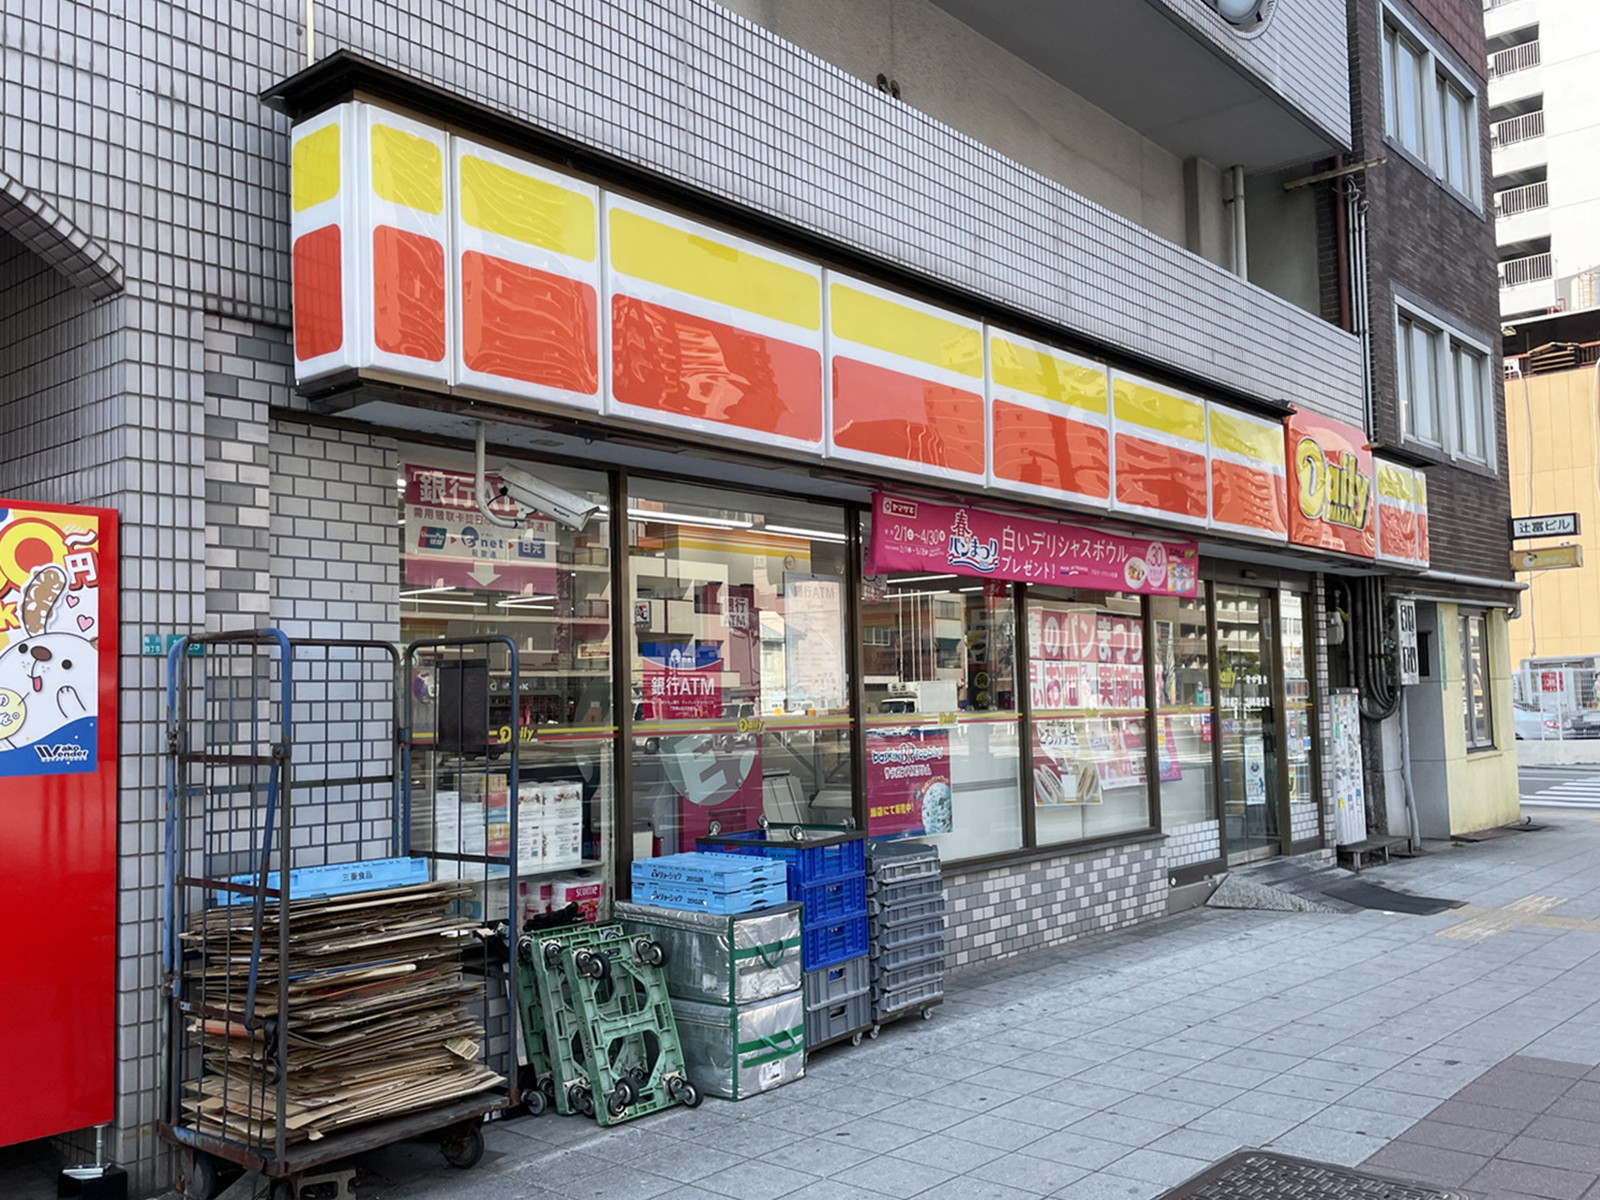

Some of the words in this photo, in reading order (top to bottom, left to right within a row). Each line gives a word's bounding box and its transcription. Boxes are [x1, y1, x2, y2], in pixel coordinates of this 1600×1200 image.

[1296, 438, 1370, 529] Daily
[1519, 519, 1571, 534] 辻富ビル
[522, 542, 543, 554] 日元
[1002, 525, 1129, 564] 白いデリシャスボウル
[1001, 556, 1056, 580] プレゼント!
[651, 676, 715, 696] 銀行ATM
[500, 725, 534, 744] Dily
[342, 871, 373, 882] 三菱食品
